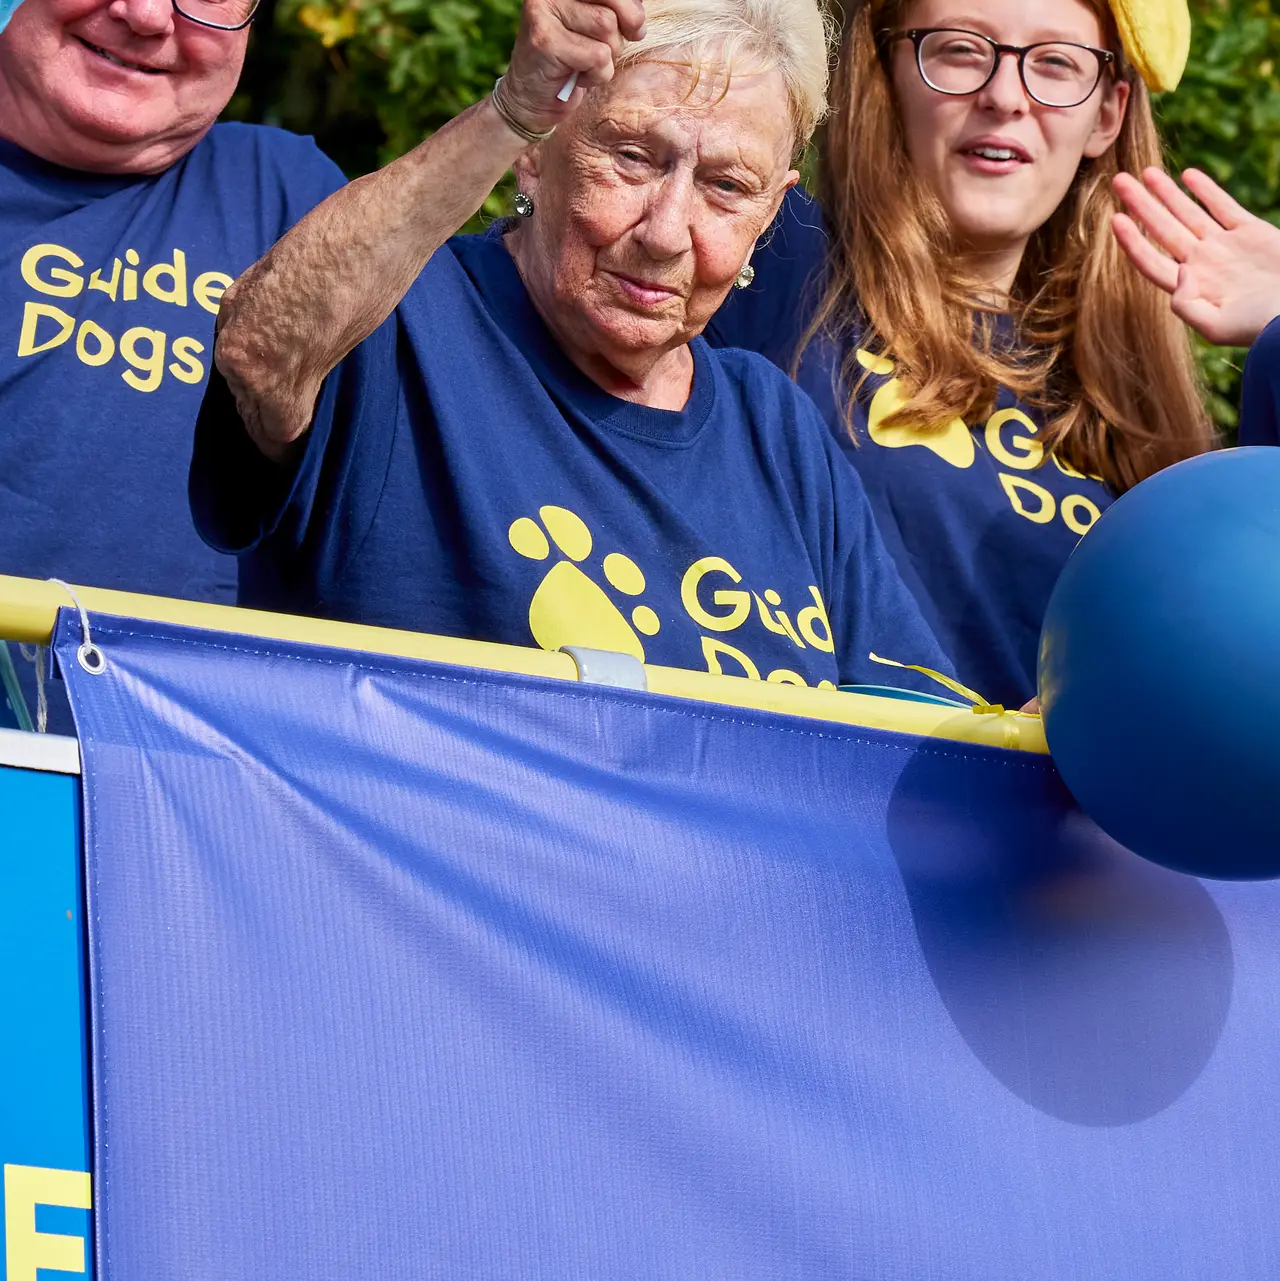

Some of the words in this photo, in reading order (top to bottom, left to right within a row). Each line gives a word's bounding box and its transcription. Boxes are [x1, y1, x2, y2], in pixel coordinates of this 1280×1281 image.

[20, 243, 235, 315] Guide
[17, 301, 205, 393] Dogs
[998, 472, 1102, 536] Do
[680, 556, 836, 656] Guid
